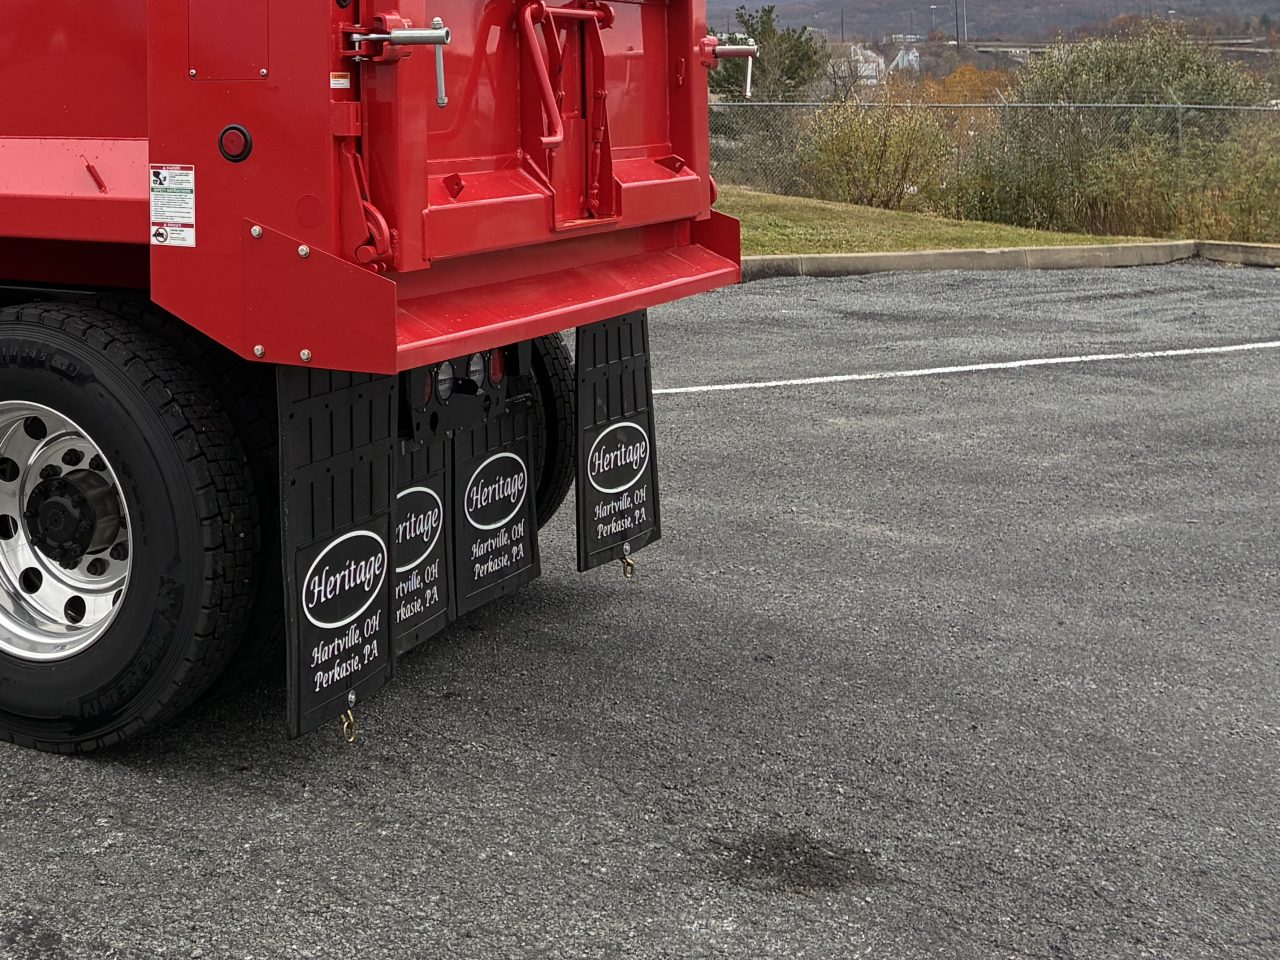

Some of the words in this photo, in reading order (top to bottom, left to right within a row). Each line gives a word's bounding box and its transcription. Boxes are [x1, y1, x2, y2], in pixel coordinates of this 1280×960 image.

[592, 441, 646, 476] Heritage
[469, 471, 524, 512] Heritage
[594, 492, 633, 521] Hartville,
[634, 484, 647, 505] OH
[395, 508, 439, 543] ritage
[471, 527, 510, 560] Hartville,
[511, 519, 525, 541] OH
[597, 514, 634, 539] Perkasie,
[634, 507, 647, 525] PA
[308, 552, 383, 608] Heritage
[395, 570, 423, 599] rtville,
[424, 559, 439, 583] OH
[473, 552, 510, 580] Perkasie,
[511, 542, 525, 562] PA
[395, 596, 424, 623] rkasie,
[425, 585, 439, 607] PA
[310, 623, 362, 668] Hartville,
[363, 609, 381, 638] OH
[314, 653, 361, 692] Perkasie,
[363, 639, 379, 665] PA
